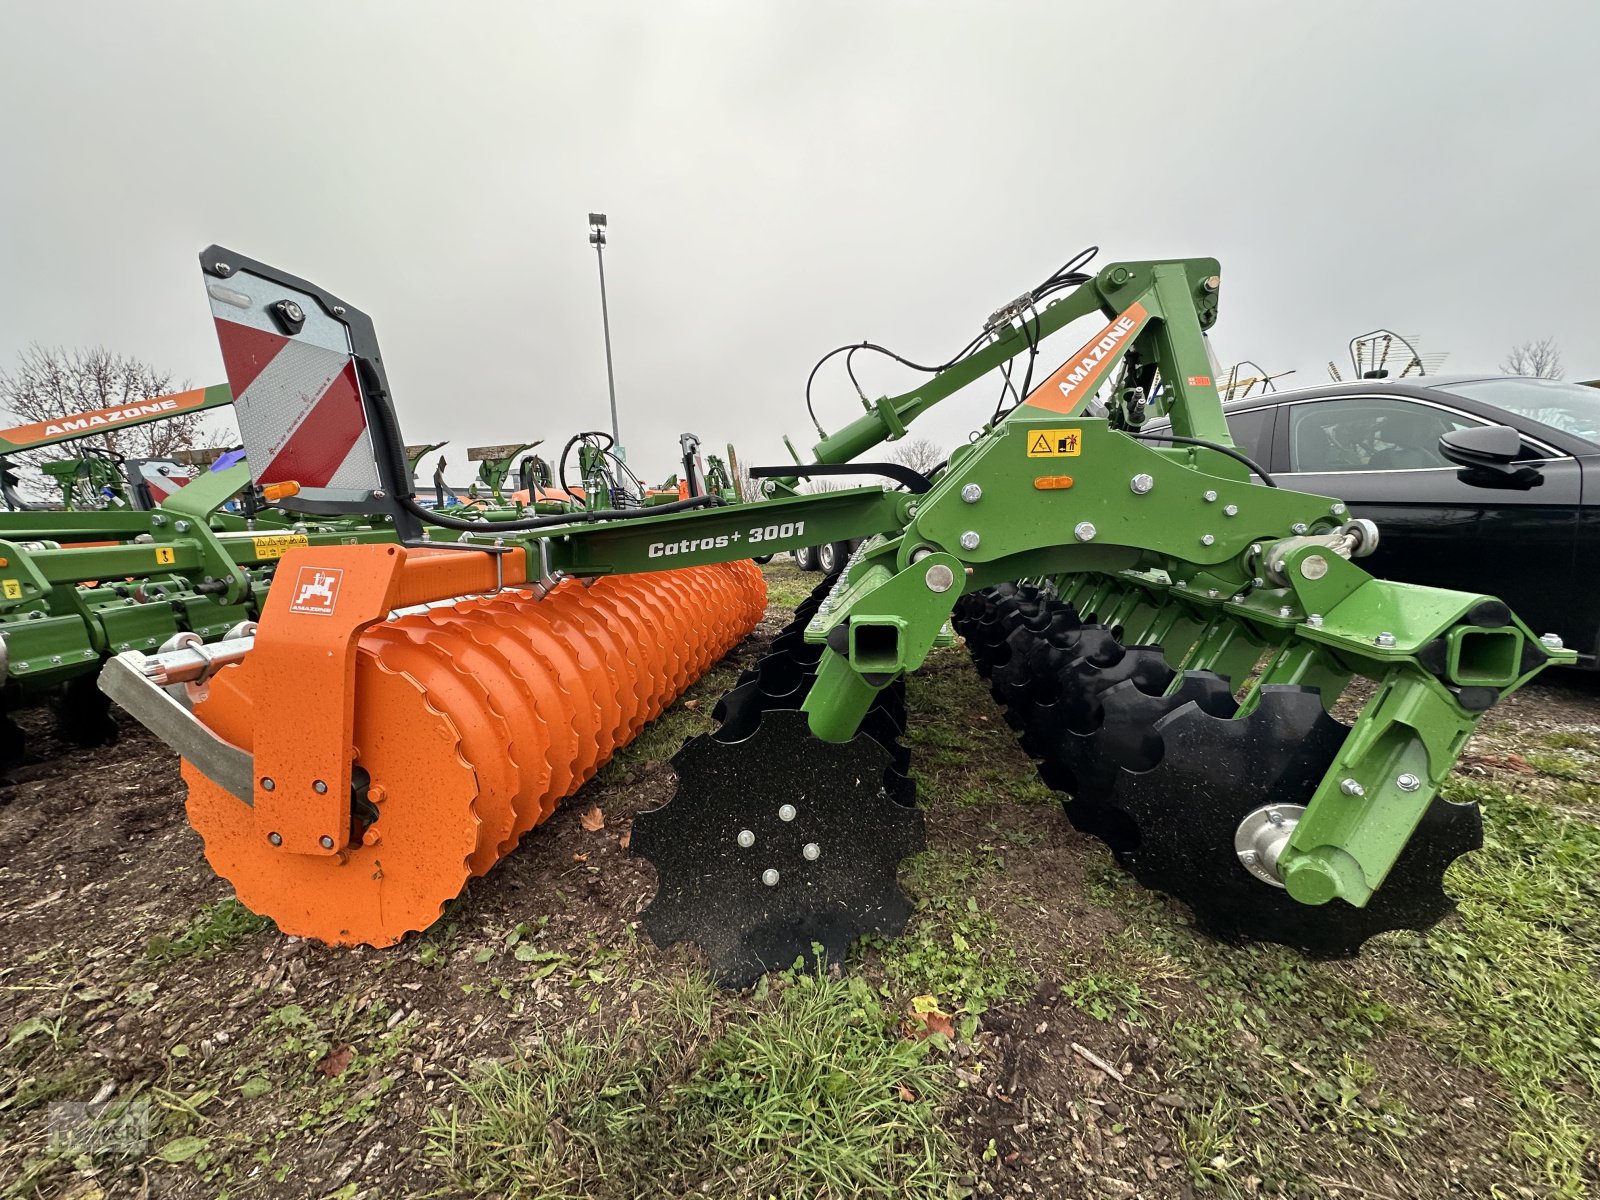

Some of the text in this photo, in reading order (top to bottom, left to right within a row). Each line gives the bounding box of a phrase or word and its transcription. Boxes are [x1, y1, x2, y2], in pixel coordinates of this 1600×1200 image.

[1058, 316, 1136, 397] AMAZONE
[44, 399, 178, 436] AMAZONE
[749, 521, 805, 543] 3001
[291, 605, 332, 613] AMAZONE
